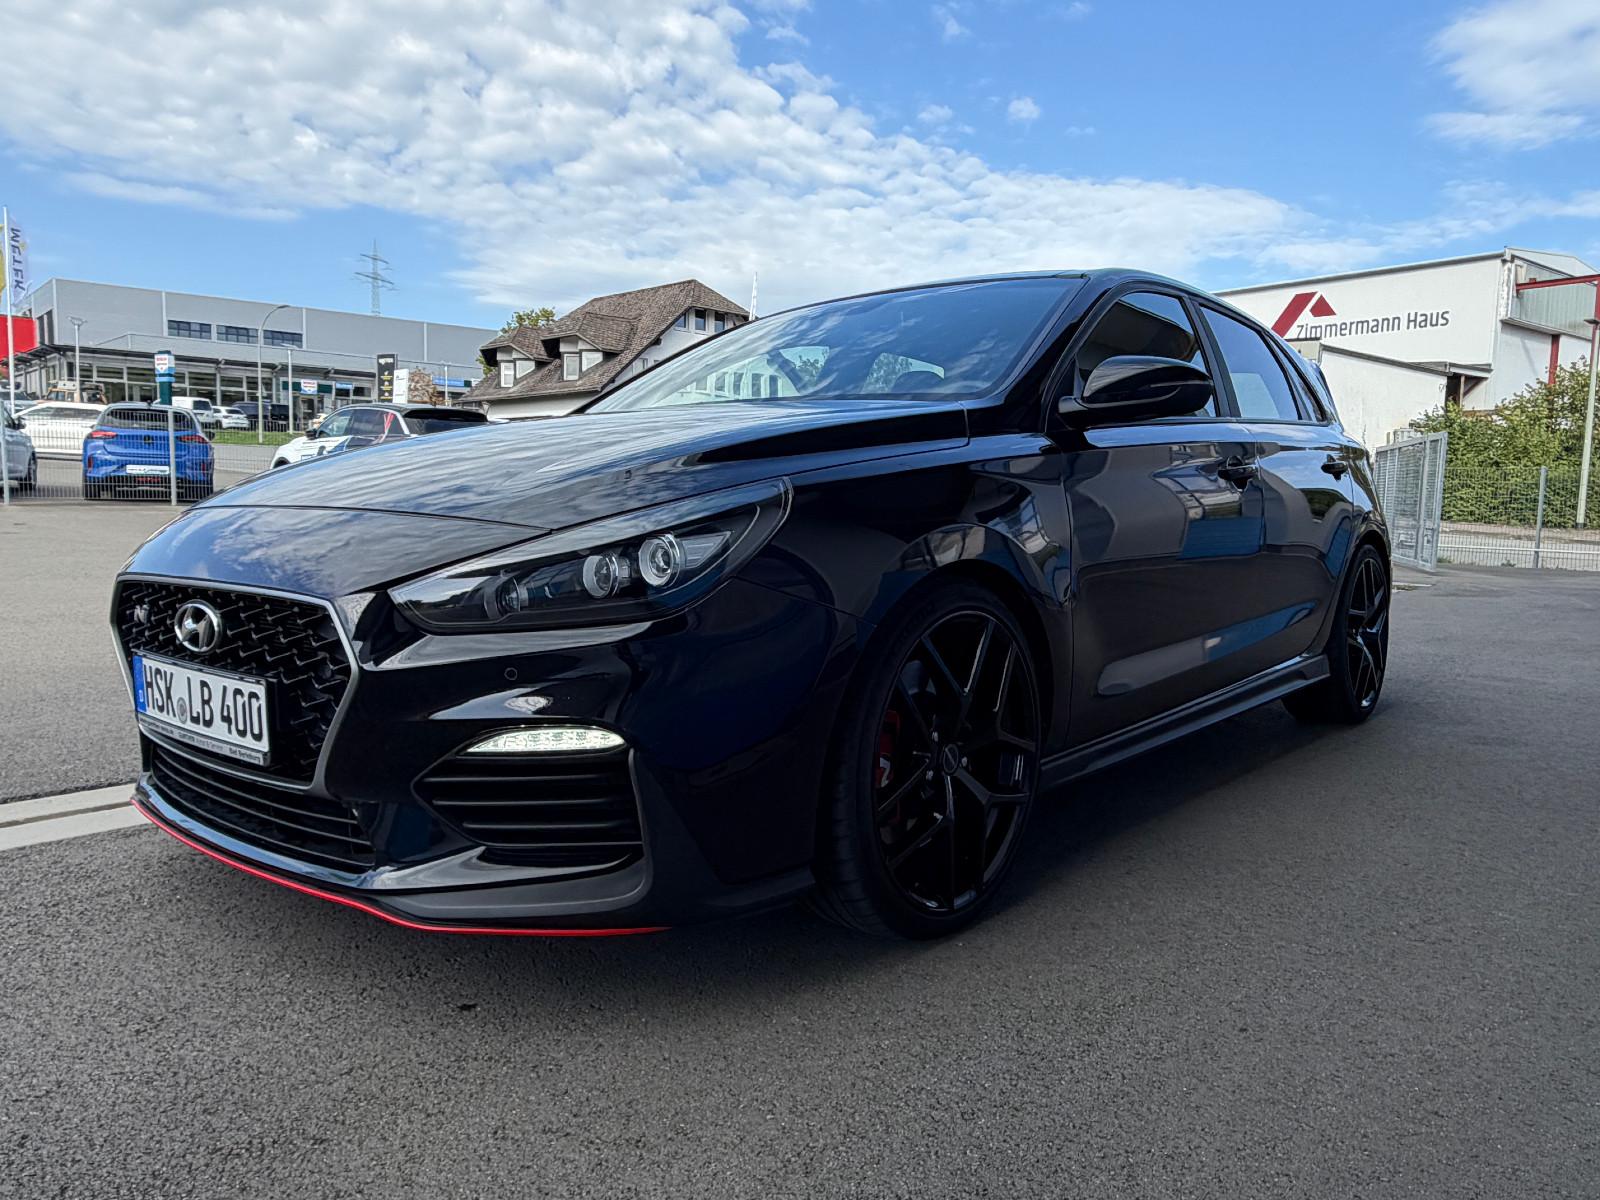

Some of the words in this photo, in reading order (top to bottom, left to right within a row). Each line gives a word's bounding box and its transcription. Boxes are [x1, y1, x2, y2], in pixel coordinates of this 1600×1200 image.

[1296, 316, 1401, 339] Zimmermann
[1406, 310, 1450, 330] Haus
[143, 664, 177, 718] HSK
[186, 676, 214, 729] LB
[220, 685, 263, 742] 400
